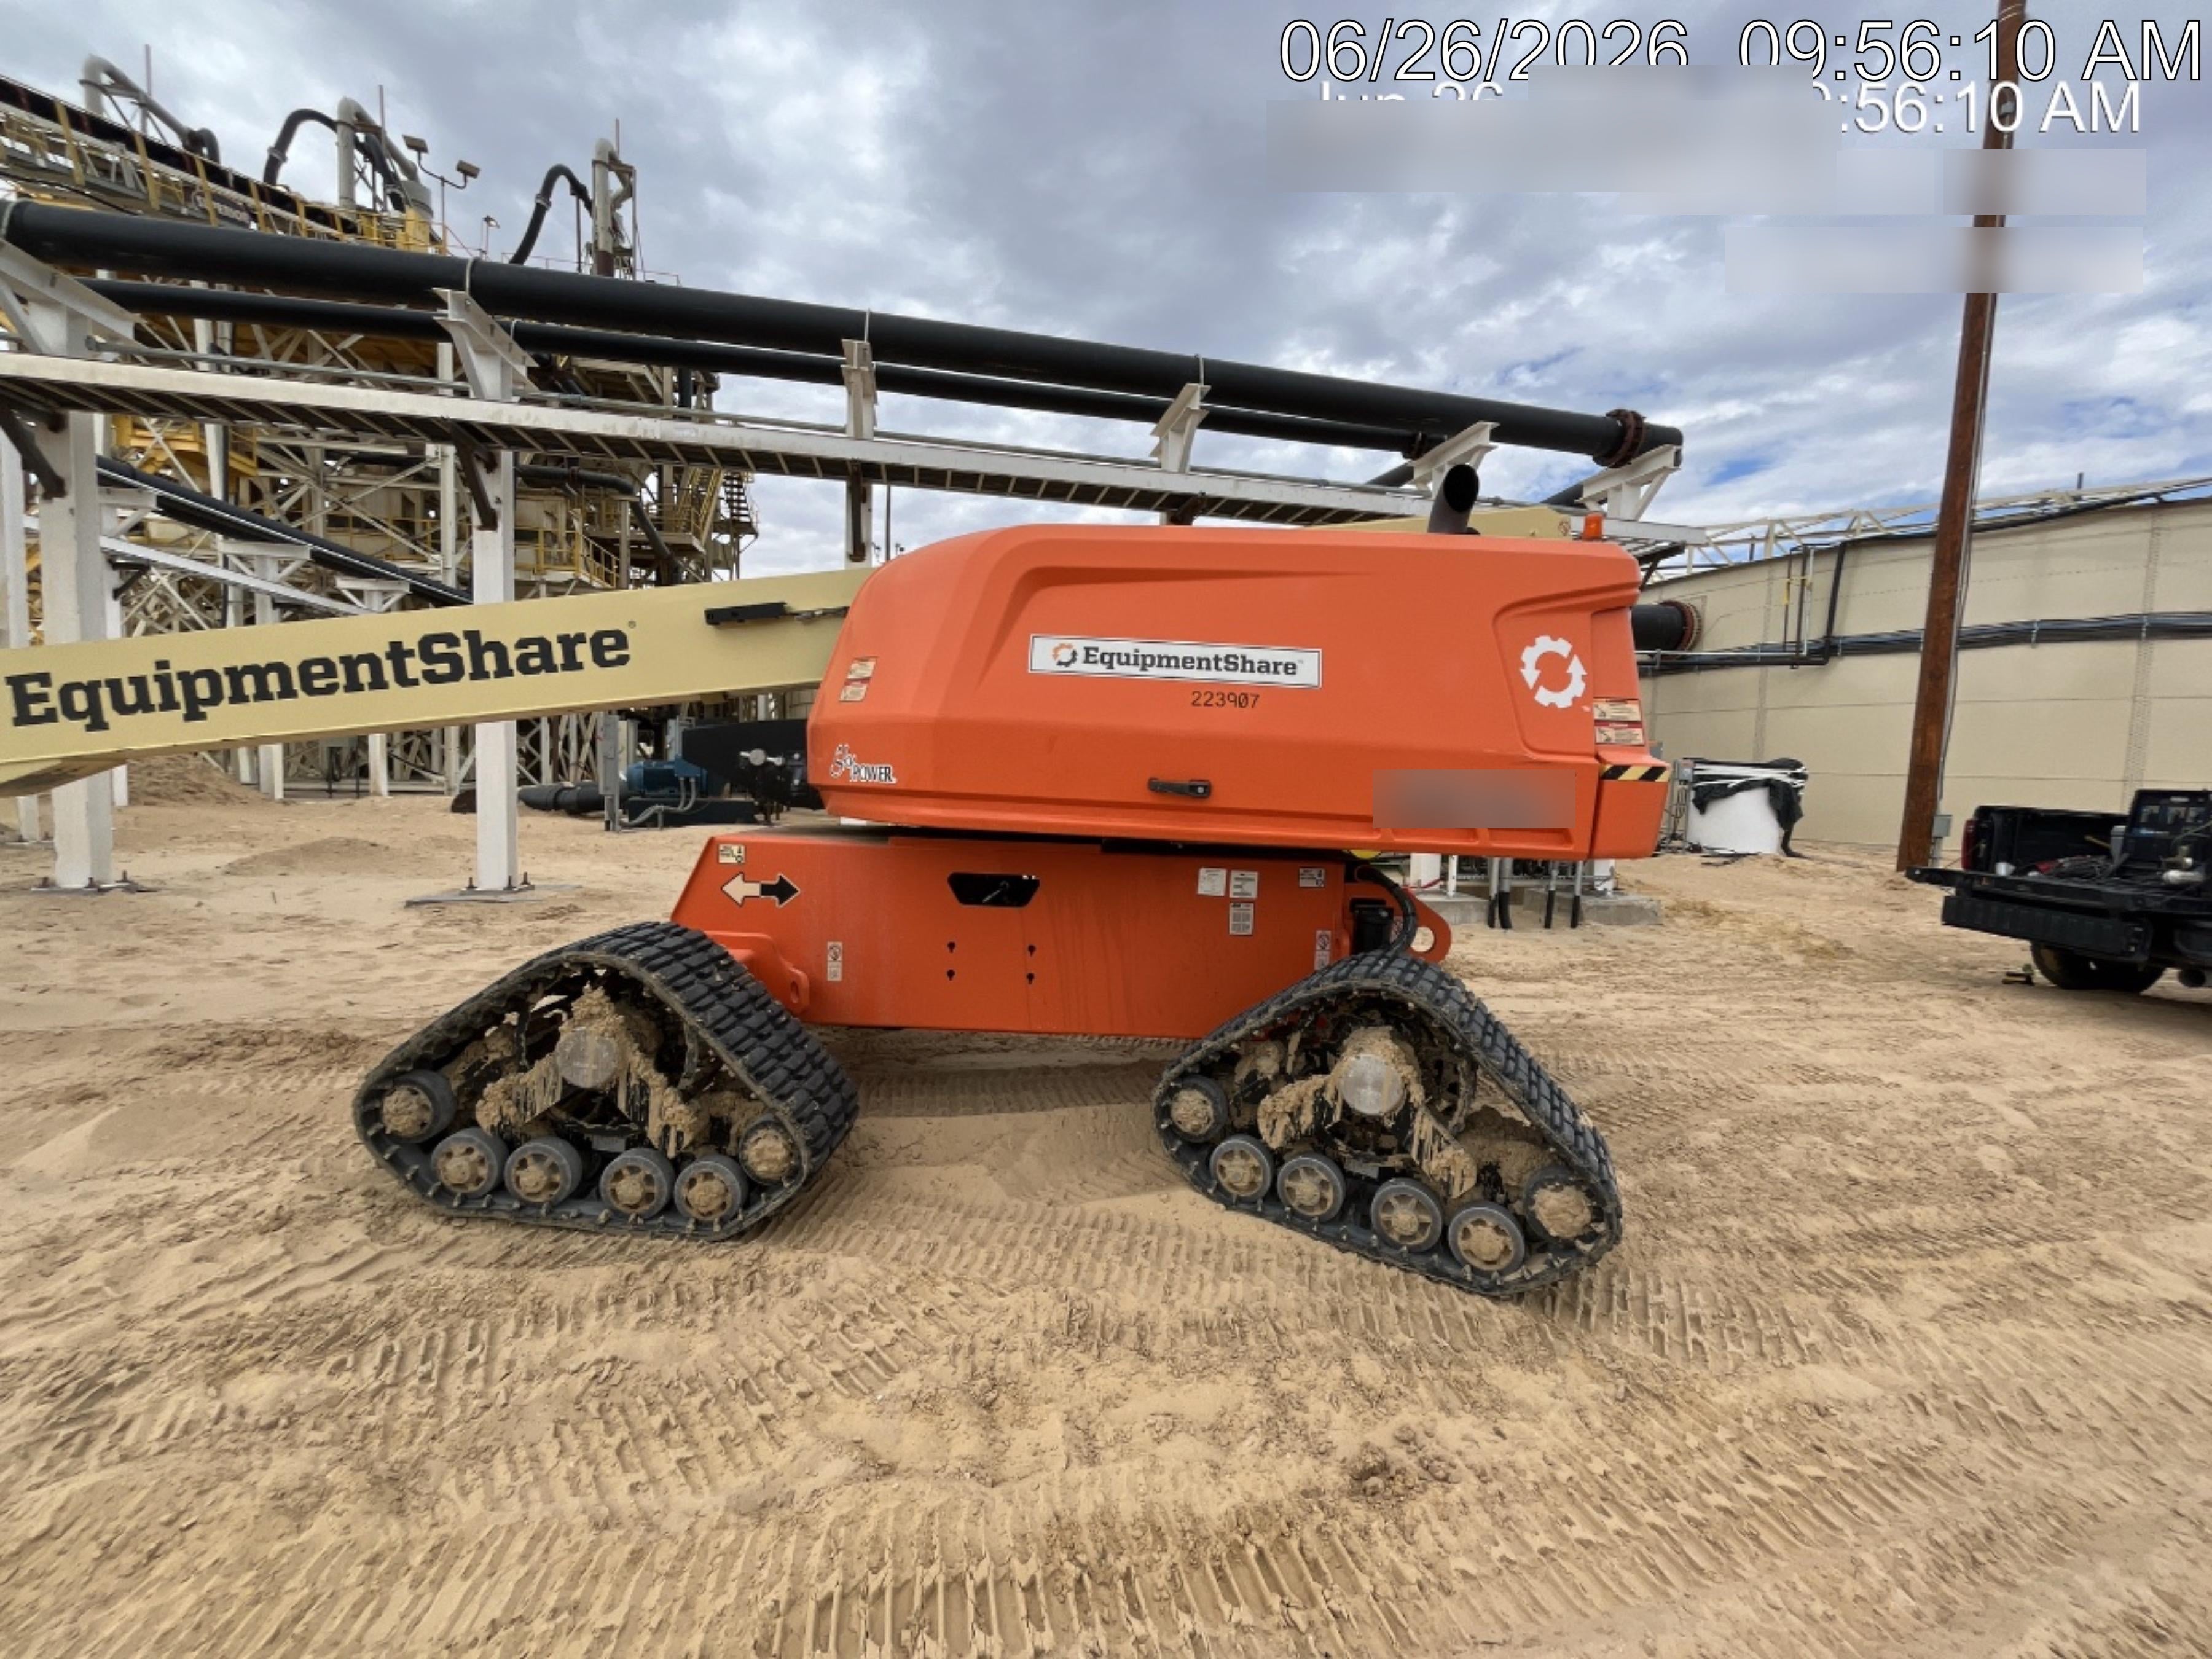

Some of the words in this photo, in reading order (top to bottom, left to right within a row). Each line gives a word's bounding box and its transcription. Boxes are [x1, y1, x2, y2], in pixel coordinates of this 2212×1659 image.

[1083, 646, 1298, 676] EquipmentShare
[6, 629, 631, 732] EquipmentShare
[1191, 691, 1260, 708] 223907
